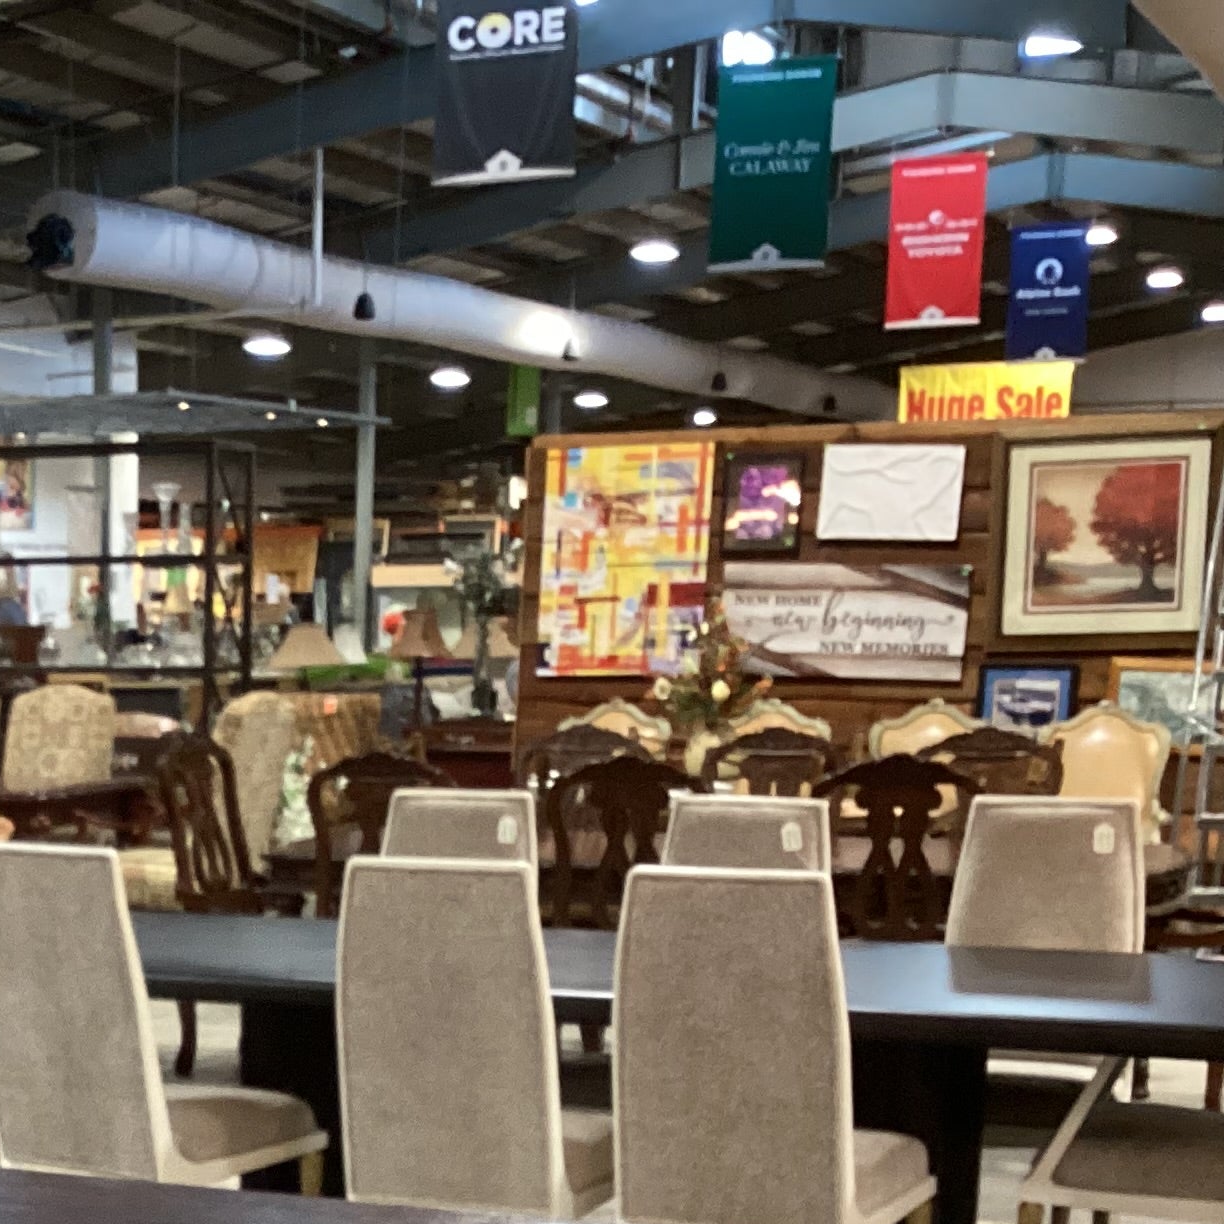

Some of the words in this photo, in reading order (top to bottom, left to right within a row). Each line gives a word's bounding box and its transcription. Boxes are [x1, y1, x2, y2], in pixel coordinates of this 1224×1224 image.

[447, 6, 567, 51] CORE
[997, 385, 1063, 419] Sale
[735, 594, 769, 606] NEW
[822, 586, 926, 642] beginning
[819, 641, 855, 656] NEW
[861, 641, 950, 657] MEMORIES
